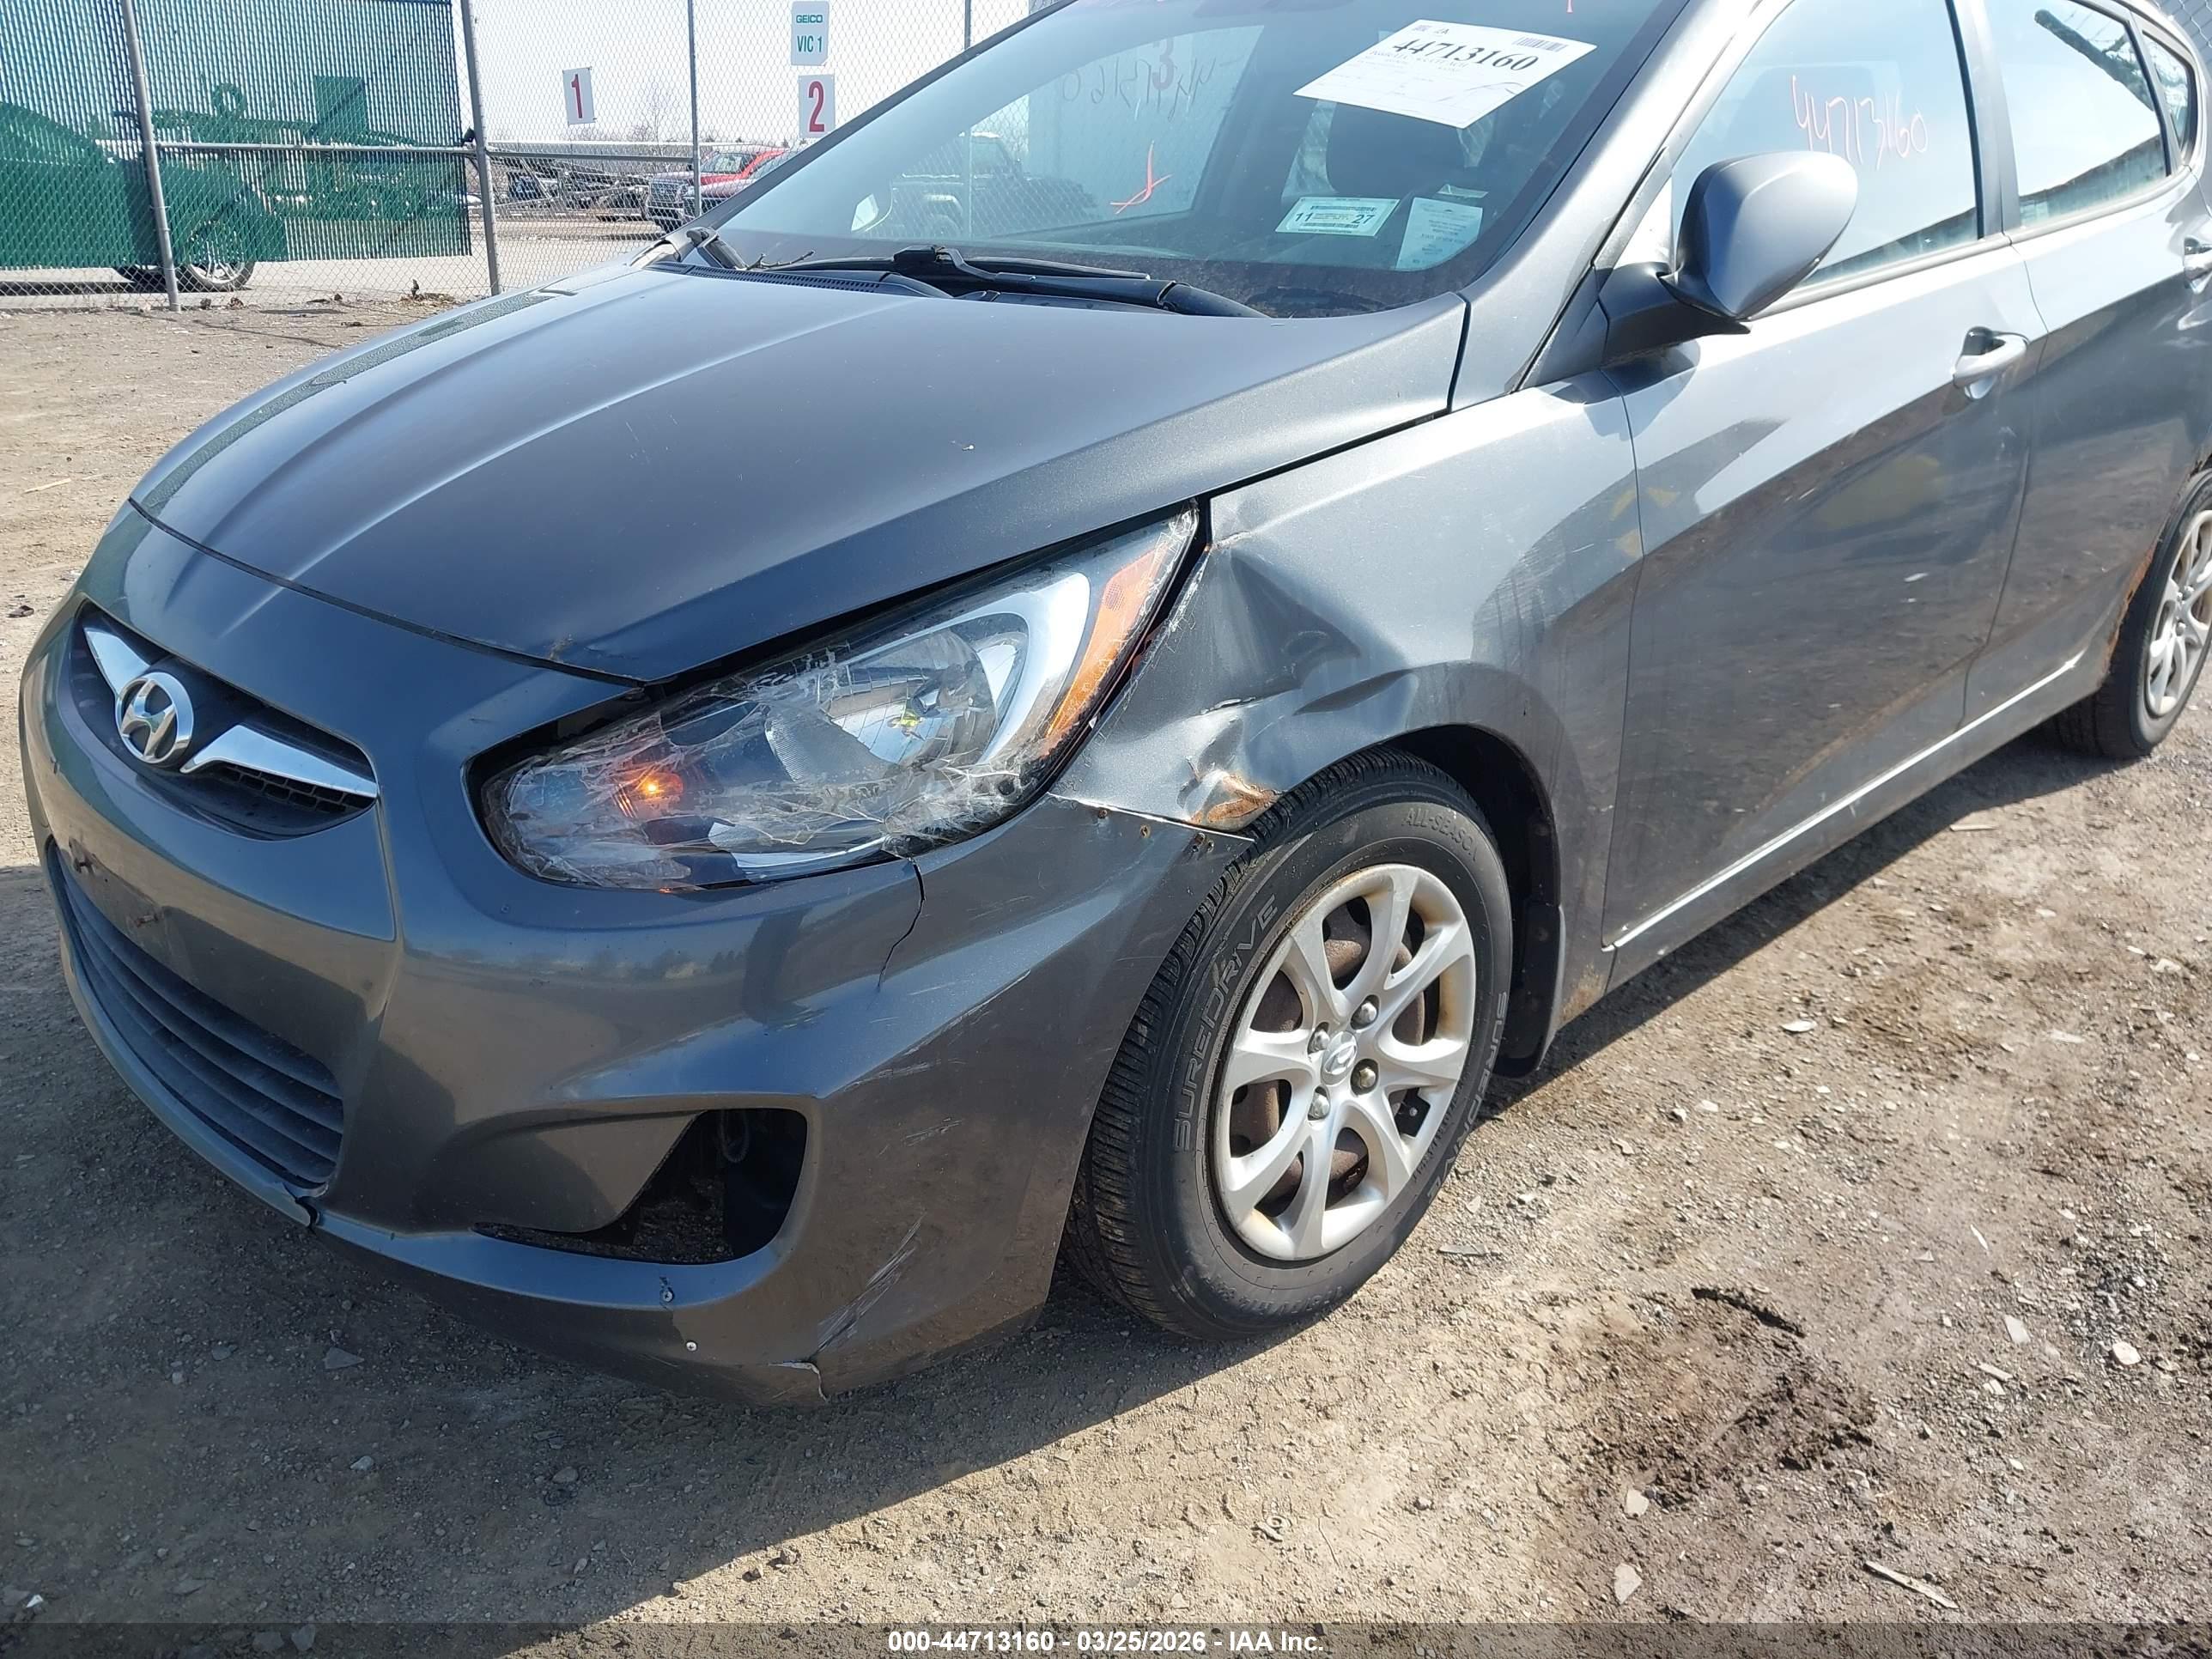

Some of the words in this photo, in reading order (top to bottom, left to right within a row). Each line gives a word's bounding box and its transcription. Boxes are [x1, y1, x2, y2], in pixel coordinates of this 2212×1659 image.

[796, 14, 823, 24] GEICO
[797, 35, 814, 52] VIC
[817, 35, 823, 52] 1
[1392, 38, 1539, 71] 44713160
[571, 73, 583, 119] 1
[808, 81, 825, 132] 2
[1791, 75, 1929, 170] 44713160
[1295, 212, 1314, 222] 11
[1352, 214, 1376, 224] 27
[1174, 894, 1278, 1152] SUREDRIVE
